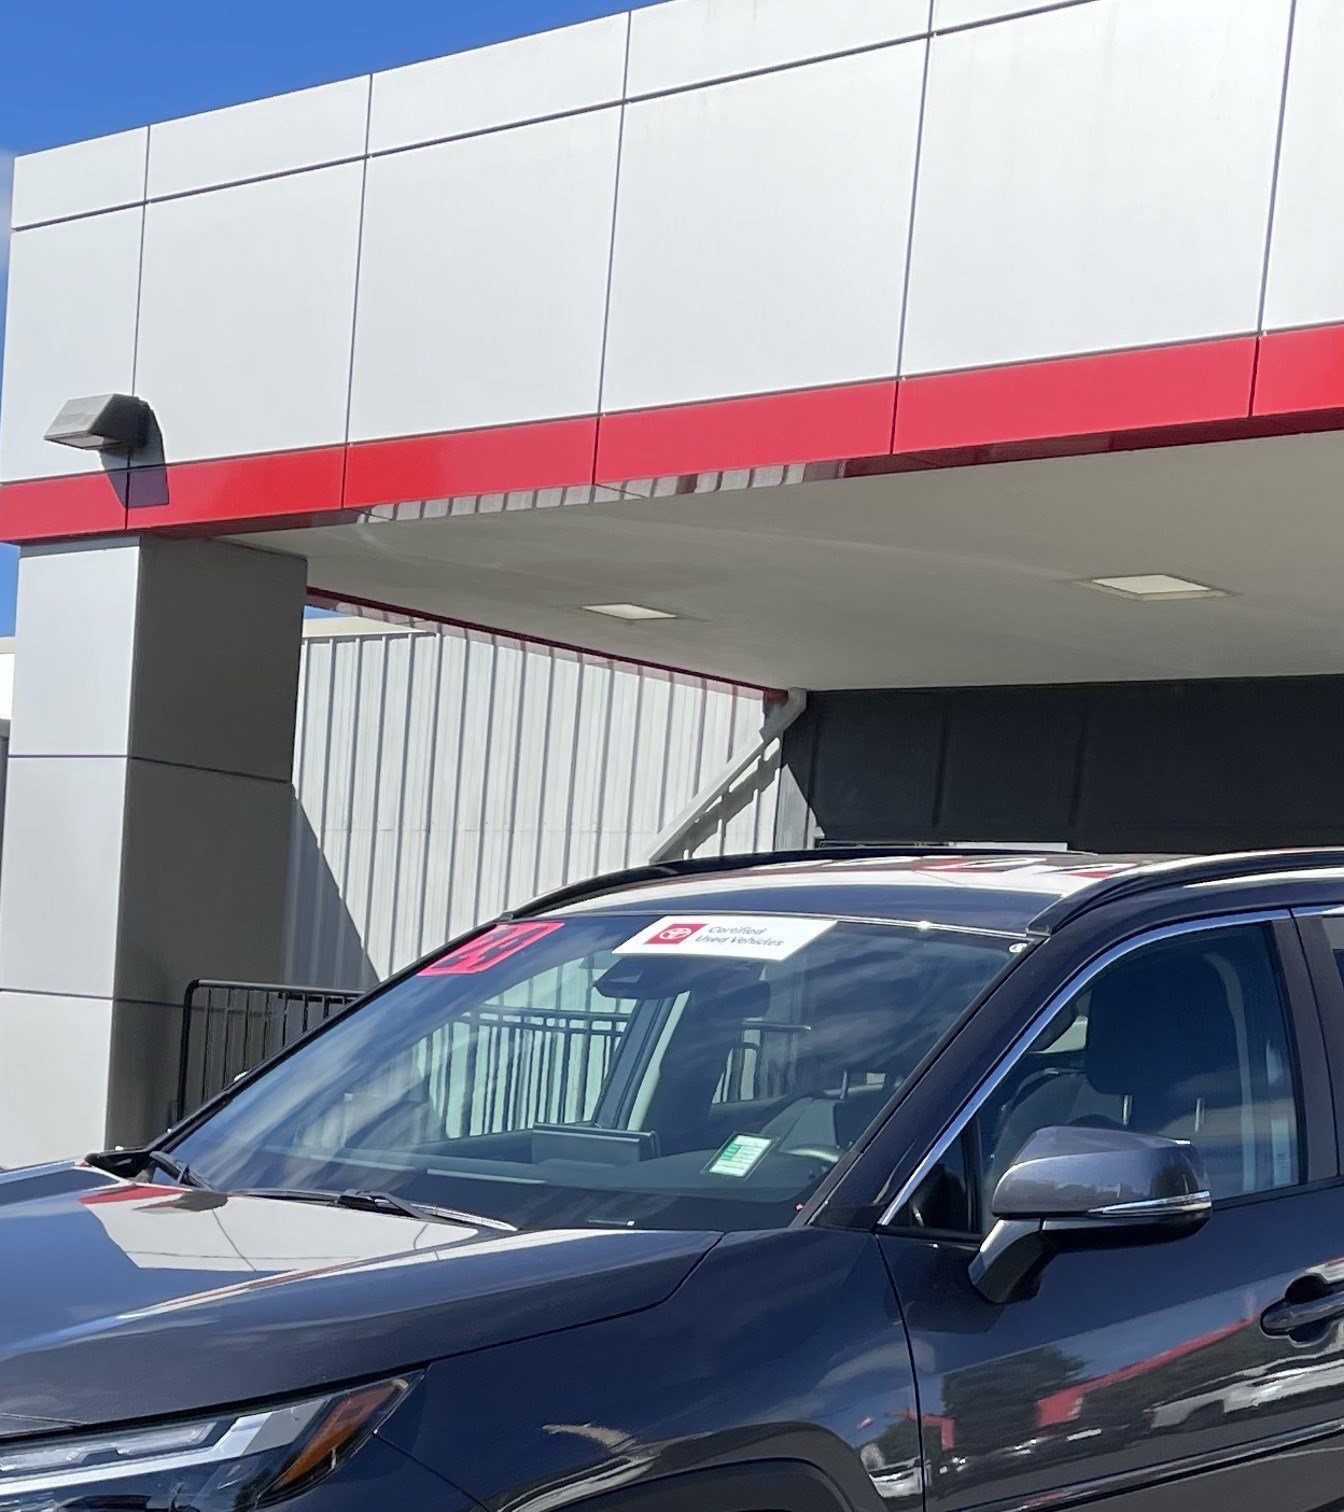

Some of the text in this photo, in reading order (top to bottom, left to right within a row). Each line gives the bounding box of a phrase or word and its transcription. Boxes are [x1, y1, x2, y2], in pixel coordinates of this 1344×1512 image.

[708, 925, 768, 936] Certified
[695, 934, 785, 947] Used Vehicles
